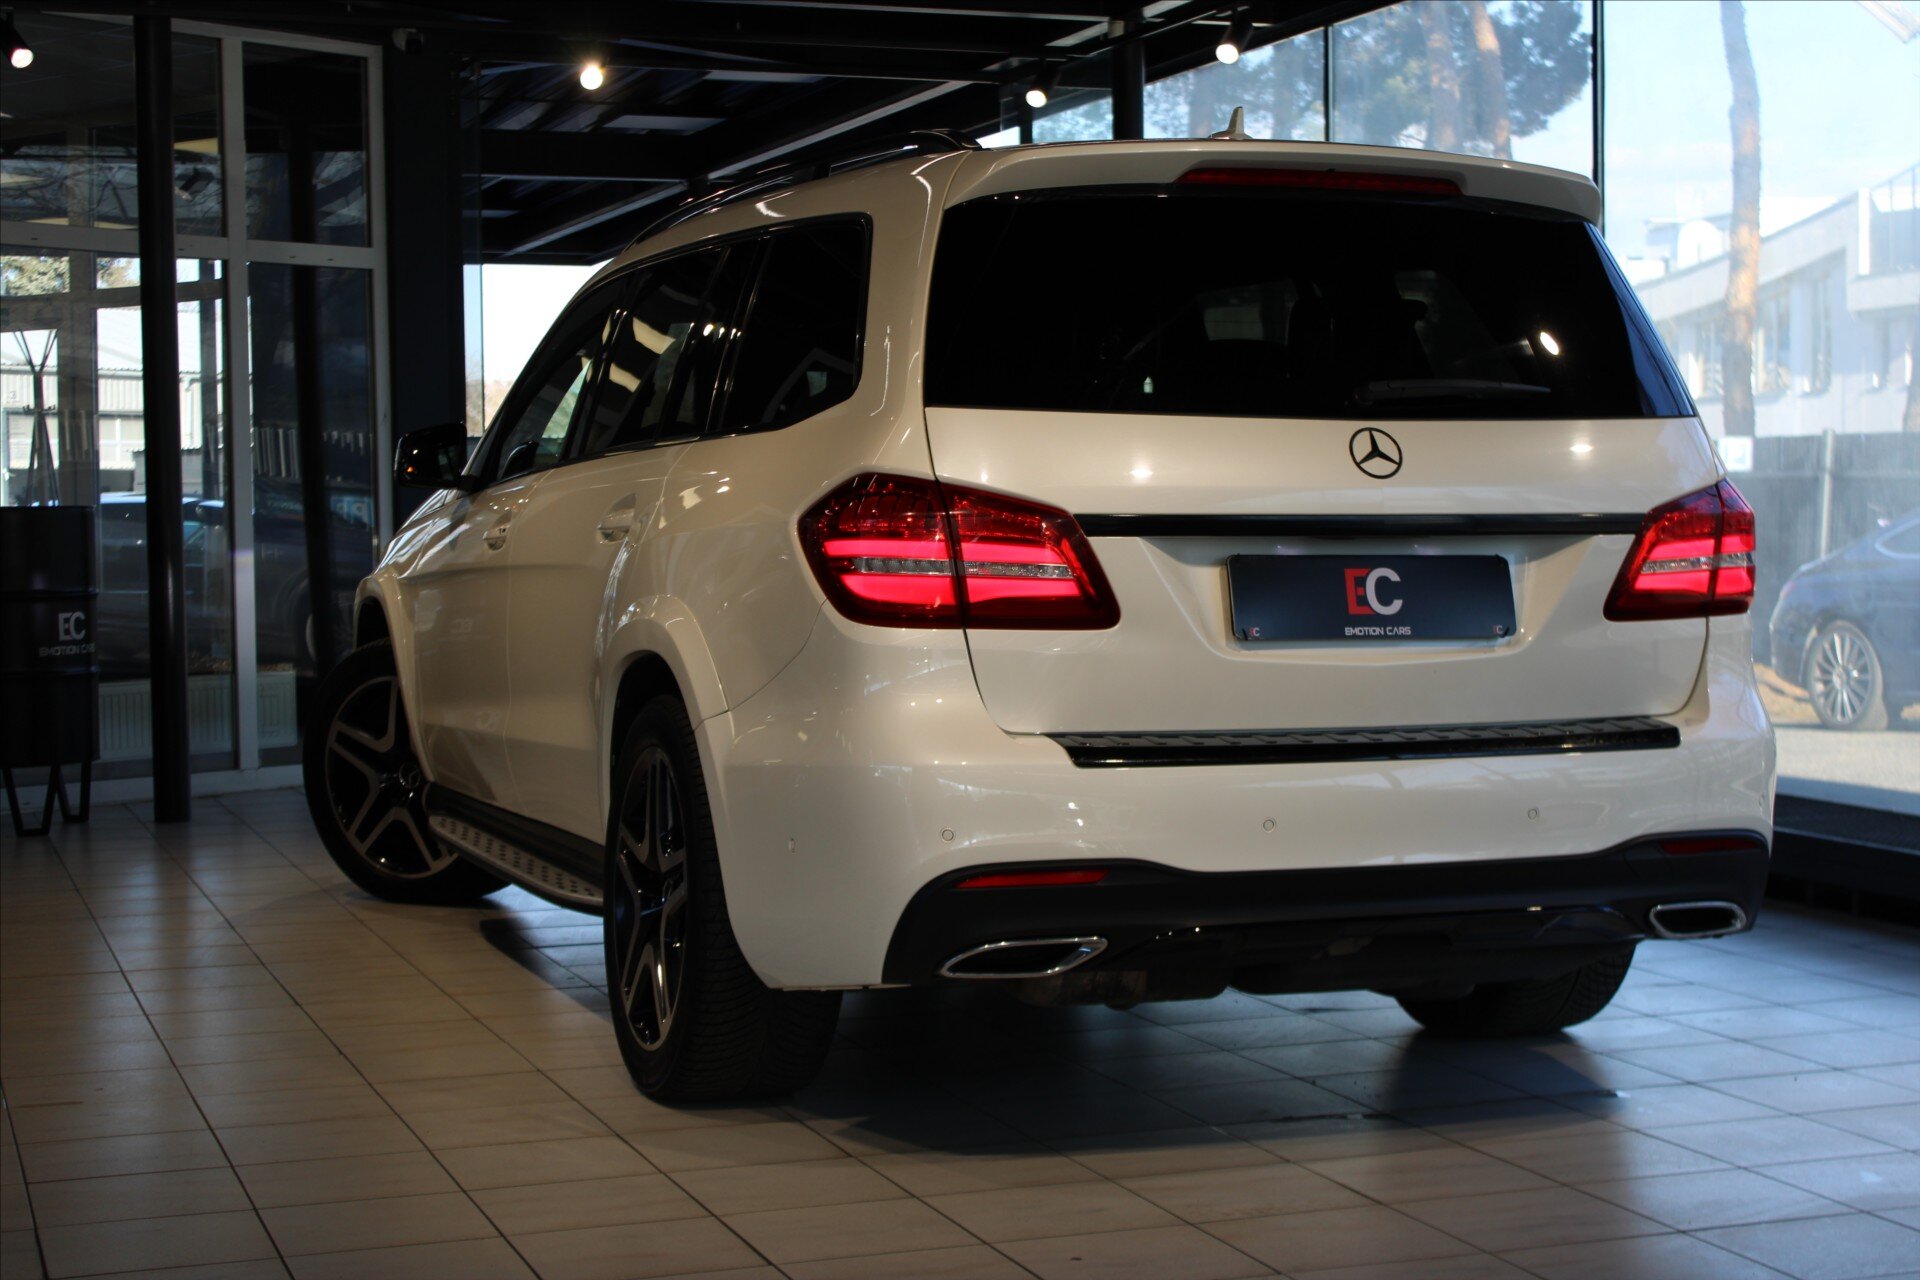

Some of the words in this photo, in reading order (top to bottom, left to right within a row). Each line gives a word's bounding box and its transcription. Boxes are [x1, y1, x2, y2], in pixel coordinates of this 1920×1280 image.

[1343, 567, 1404, 616] EC
[58, 611, 86, 641] EC
[1344, 626, 1384, 636] EMOTION
[1386, 626, 1412, 636] CARS
